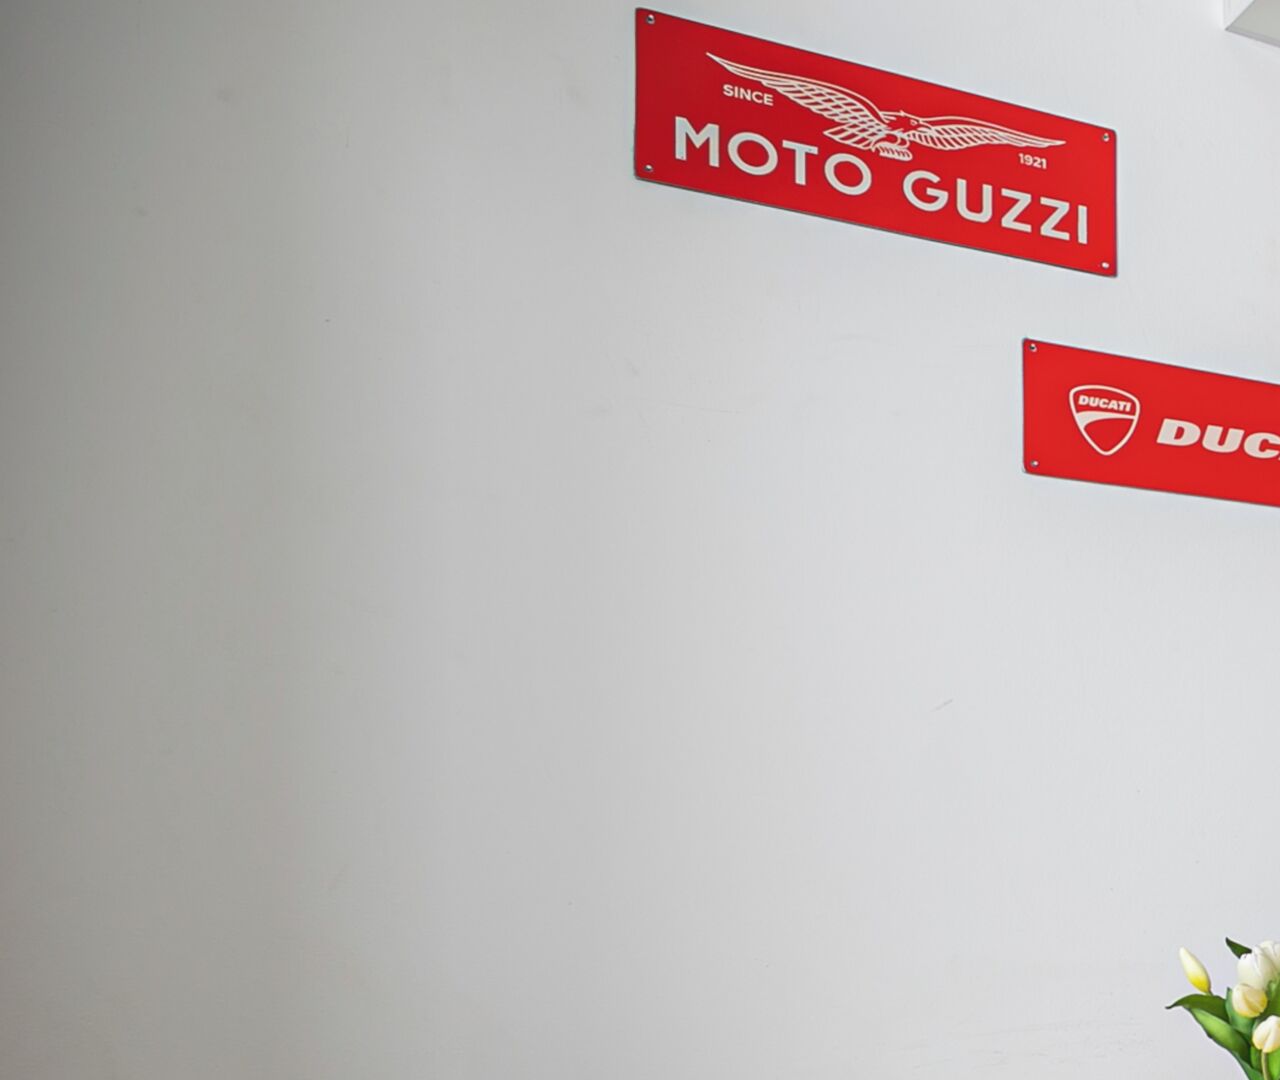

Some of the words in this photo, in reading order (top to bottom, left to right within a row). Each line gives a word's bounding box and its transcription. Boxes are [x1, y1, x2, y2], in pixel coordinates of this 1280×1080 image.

[723, 84, 774, 106] SINCE
[1018, 153, 1047, 169] 1921
[674, 116, 873, 196] MOTO
[903, 170, 1089, 245] GUZZI
[1078, 395, 1132, 412] DUCATI
